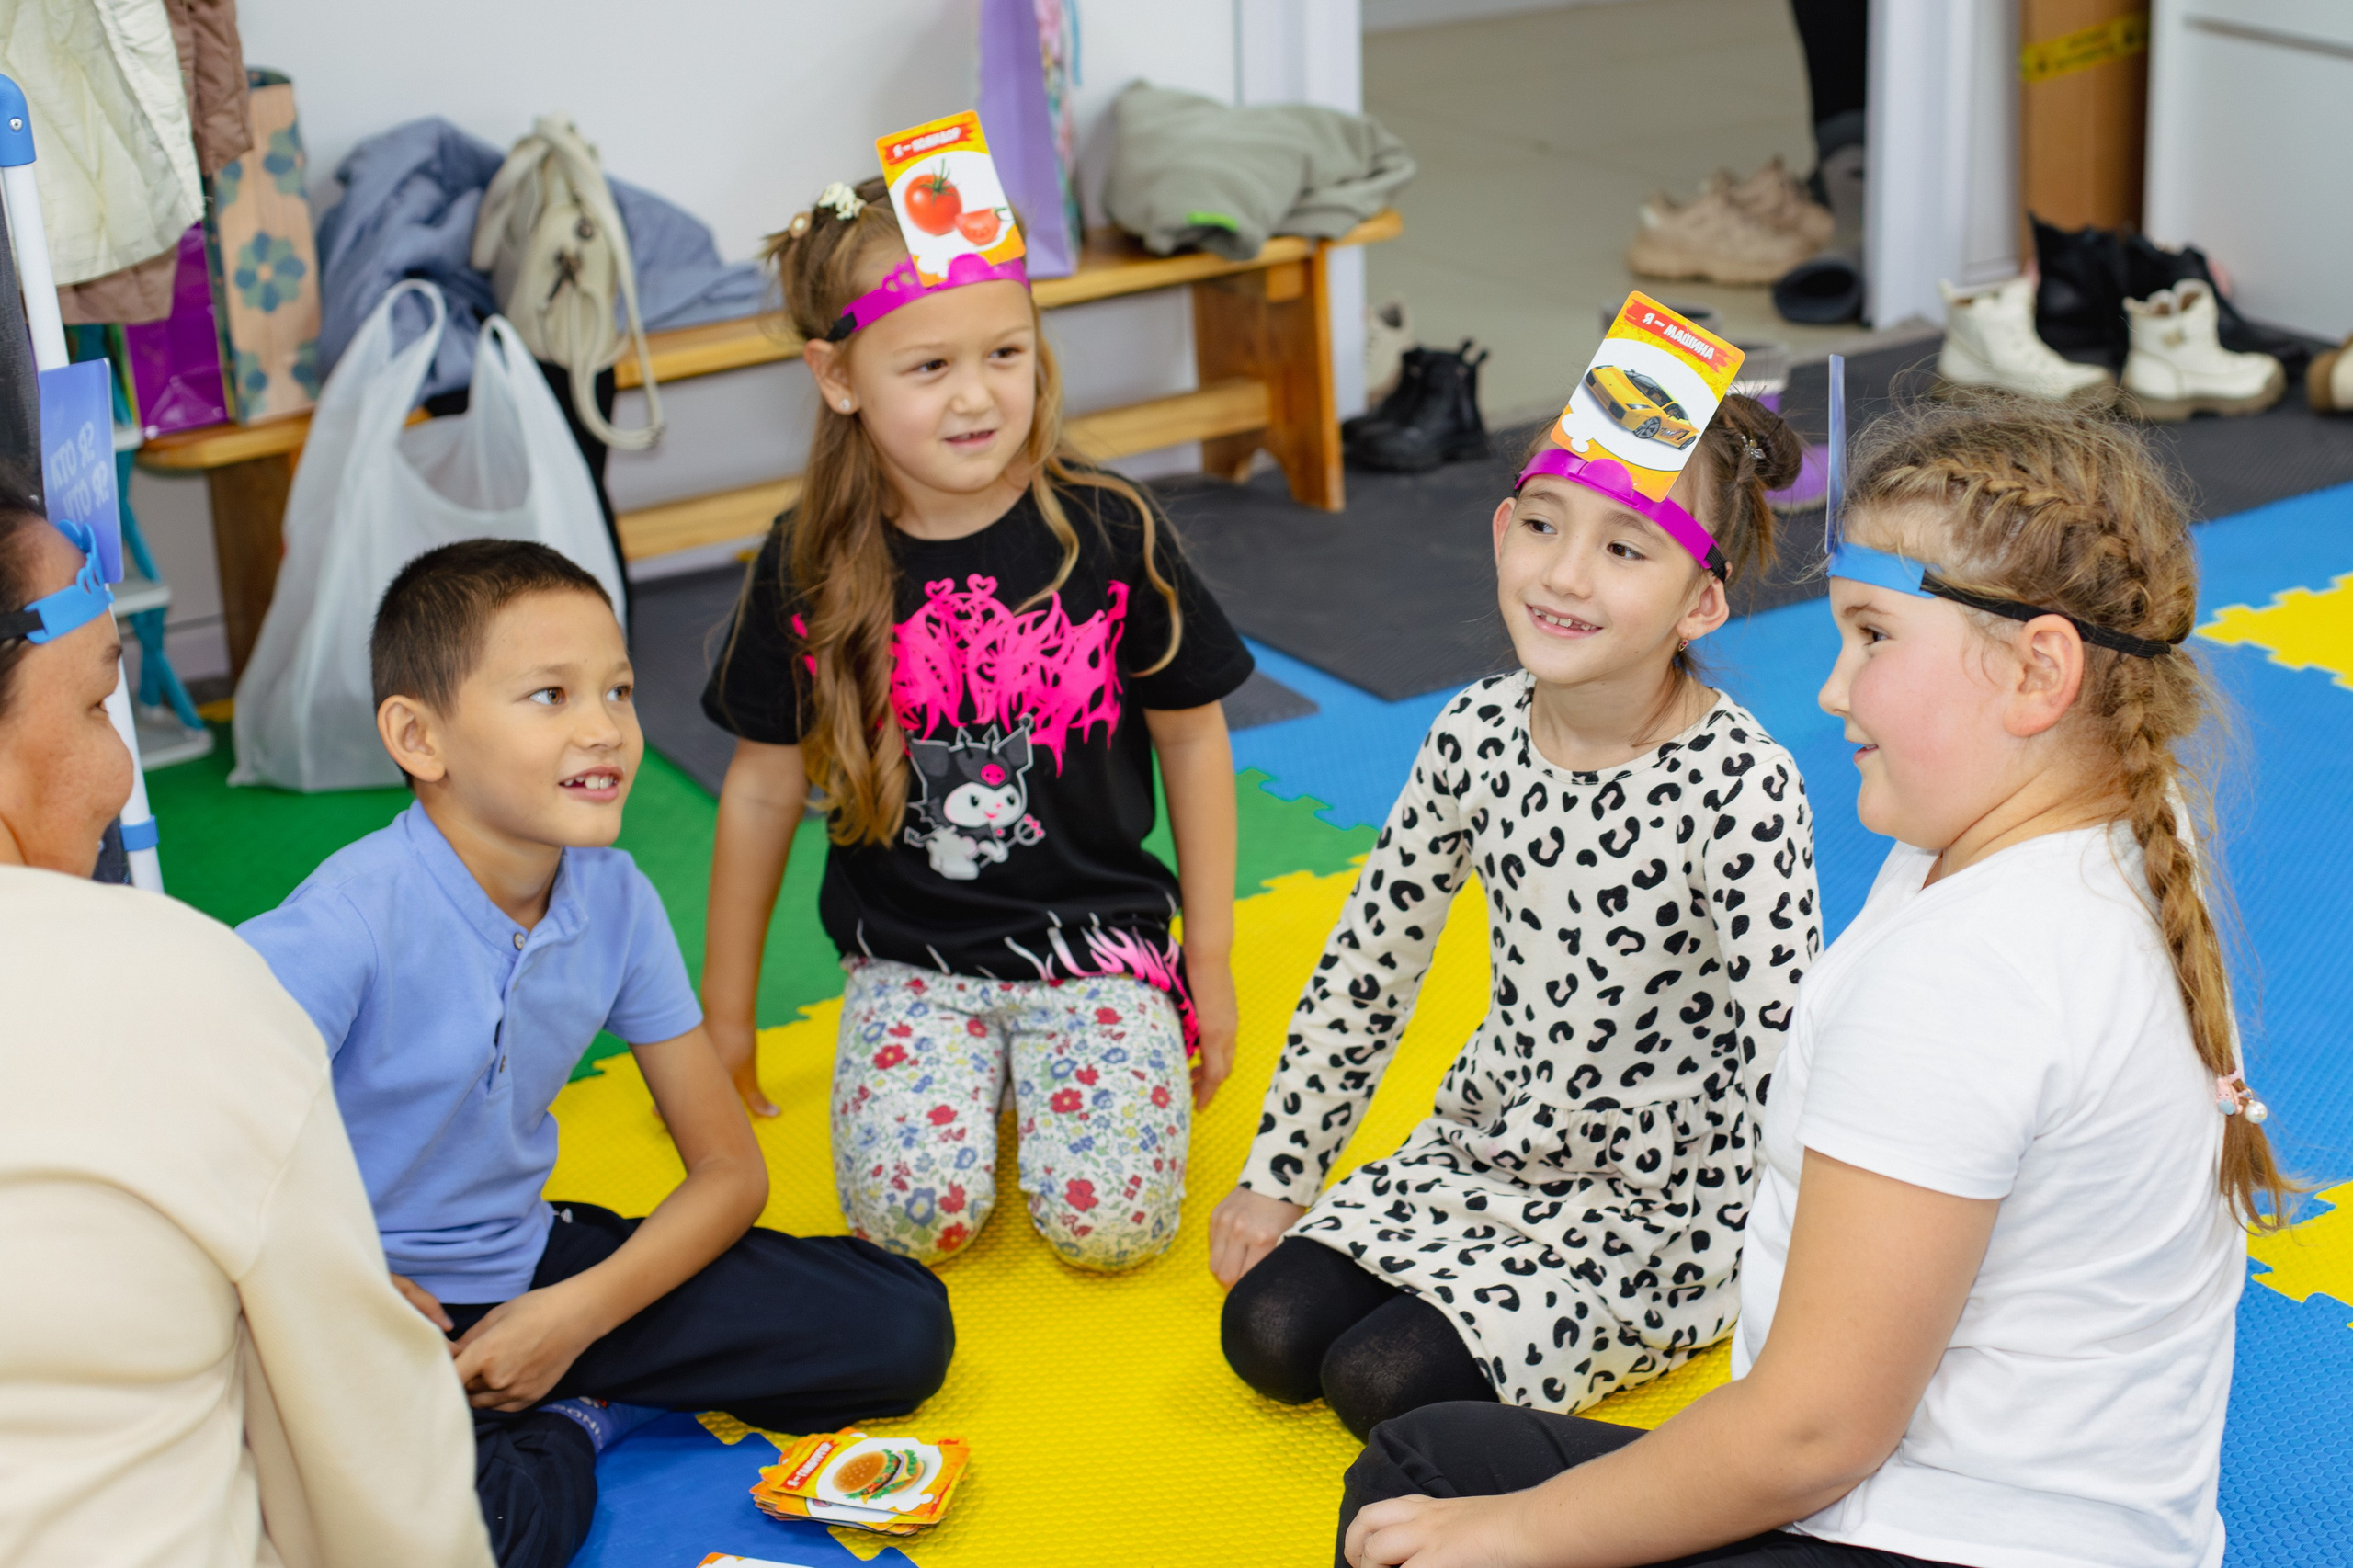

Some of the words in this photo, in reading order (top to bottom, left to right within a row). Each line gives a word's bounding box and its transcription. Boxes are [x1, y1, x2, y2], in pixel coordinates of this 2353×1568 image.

[1642, 312, 1656, 325] Я
[1663, 324, 1715, 360] МАШИНА
[50, 438, 77, 491] КТО
